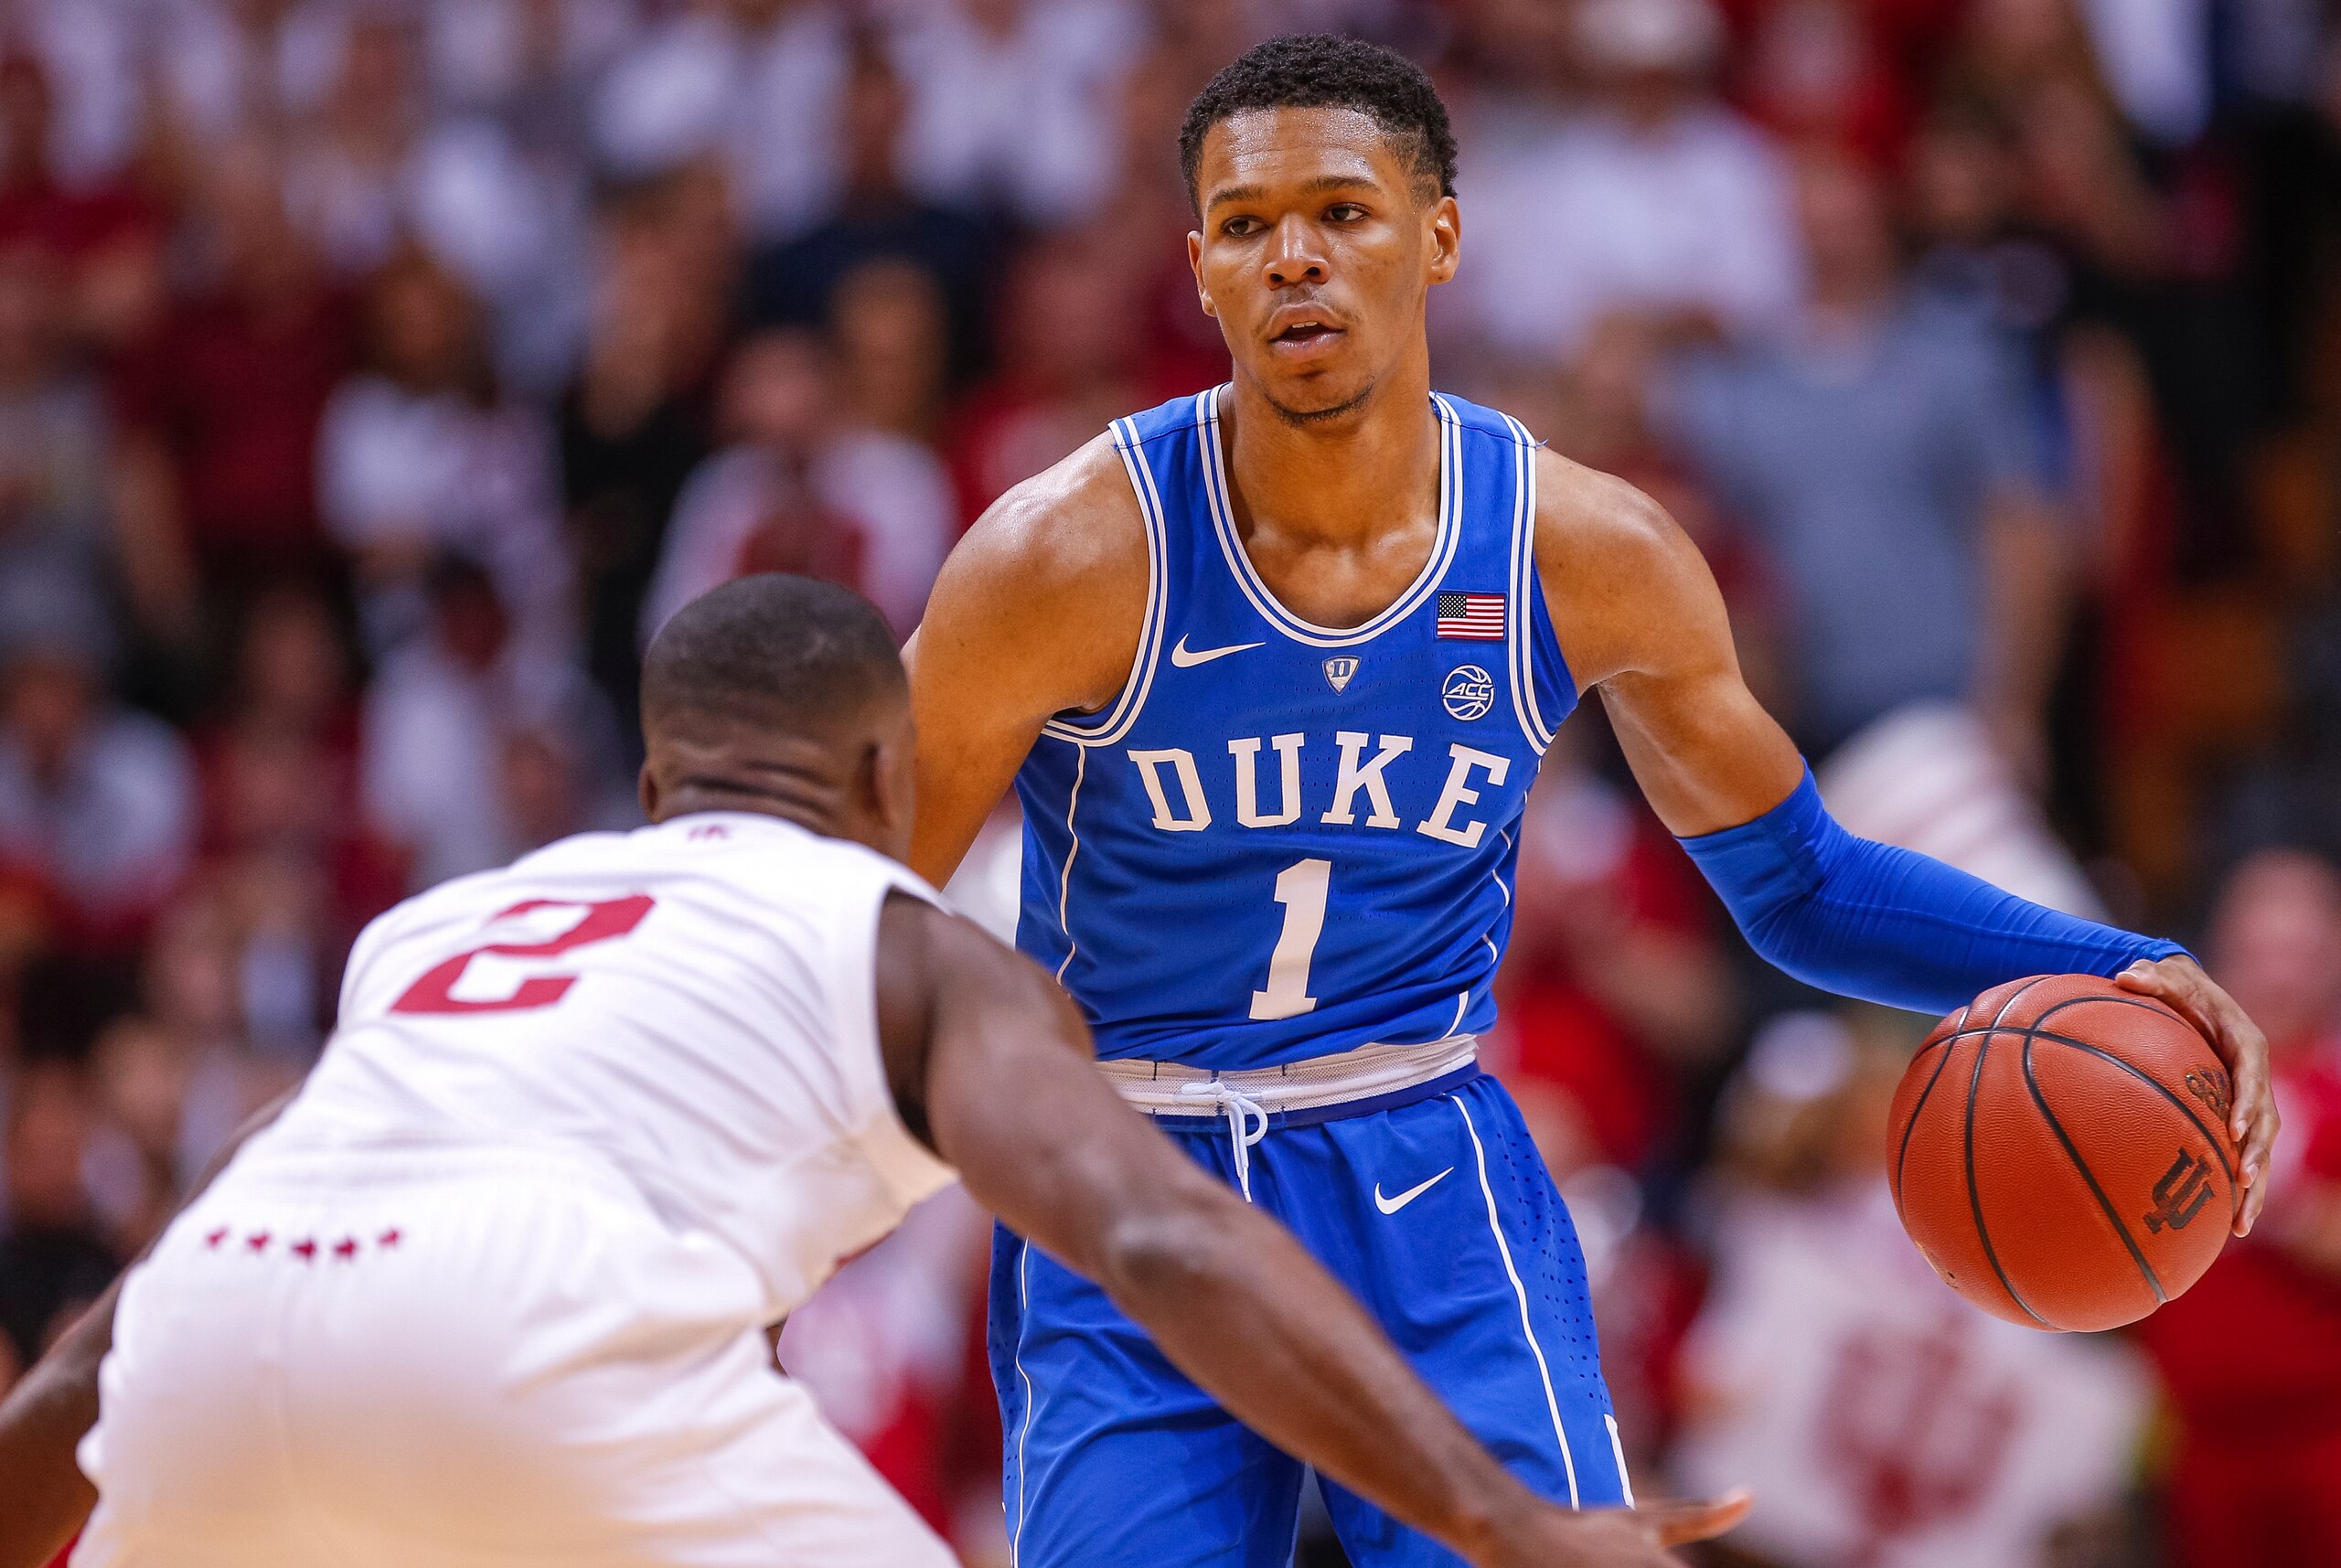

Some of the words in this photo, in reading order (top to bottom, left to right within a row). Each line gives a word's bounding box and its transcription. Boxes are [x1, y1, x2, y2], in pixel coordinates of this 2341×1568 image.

[1448, 682, 1492, 698] ACC
[1126, 731, 1511, 848] DUKE
[386, 892, 658, 1018] 2
[1248, 858, 1331, 1020] 1
